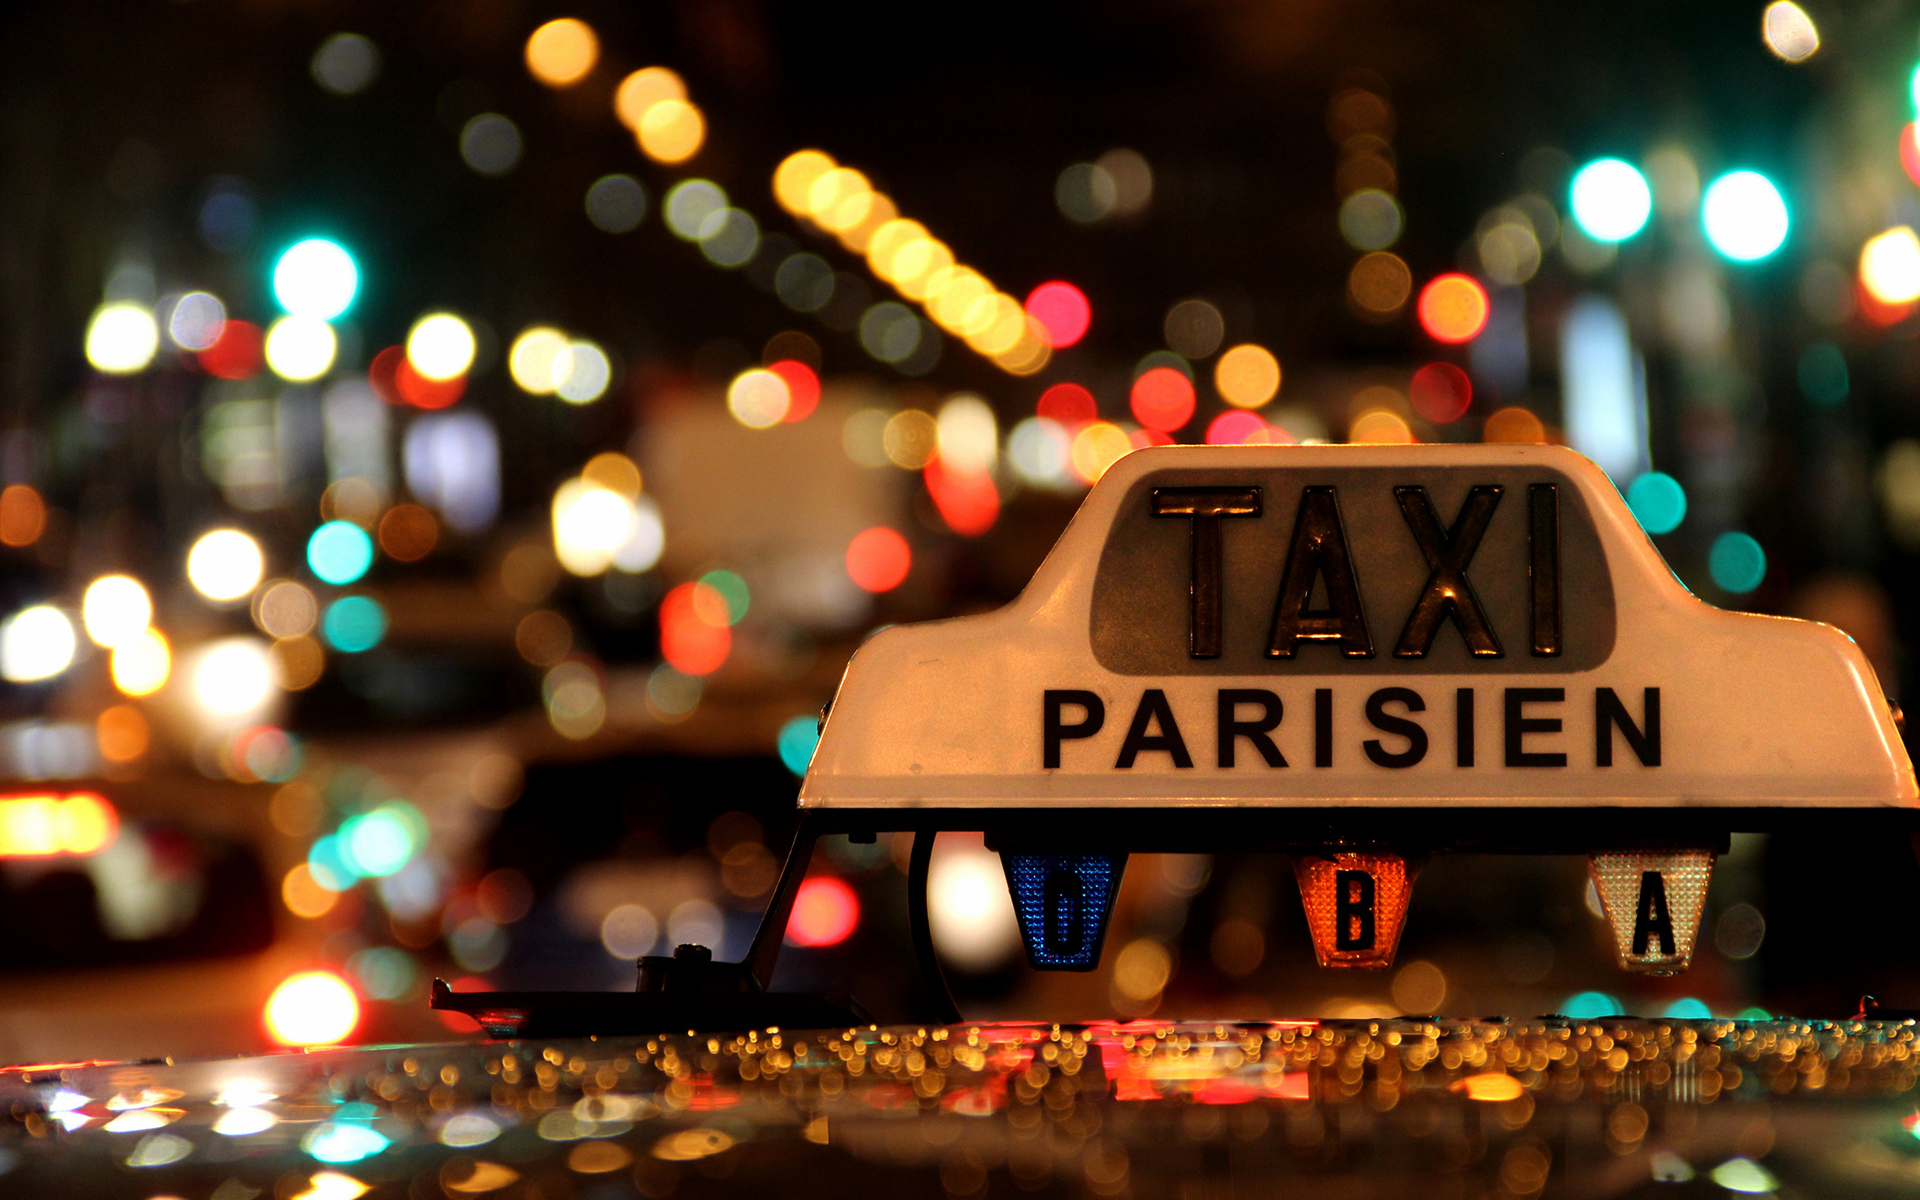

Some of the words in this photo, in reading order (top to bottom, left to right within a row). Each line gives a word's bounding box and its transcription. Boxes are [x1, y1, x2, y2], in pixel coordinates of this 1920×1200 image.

[1151, 484, 1563, 659] TAXI
[1043, 687, 1661, 769] PARISIEN
[1336, 870, 1374, 951] B
[1632, 871, 1675, 954] A
